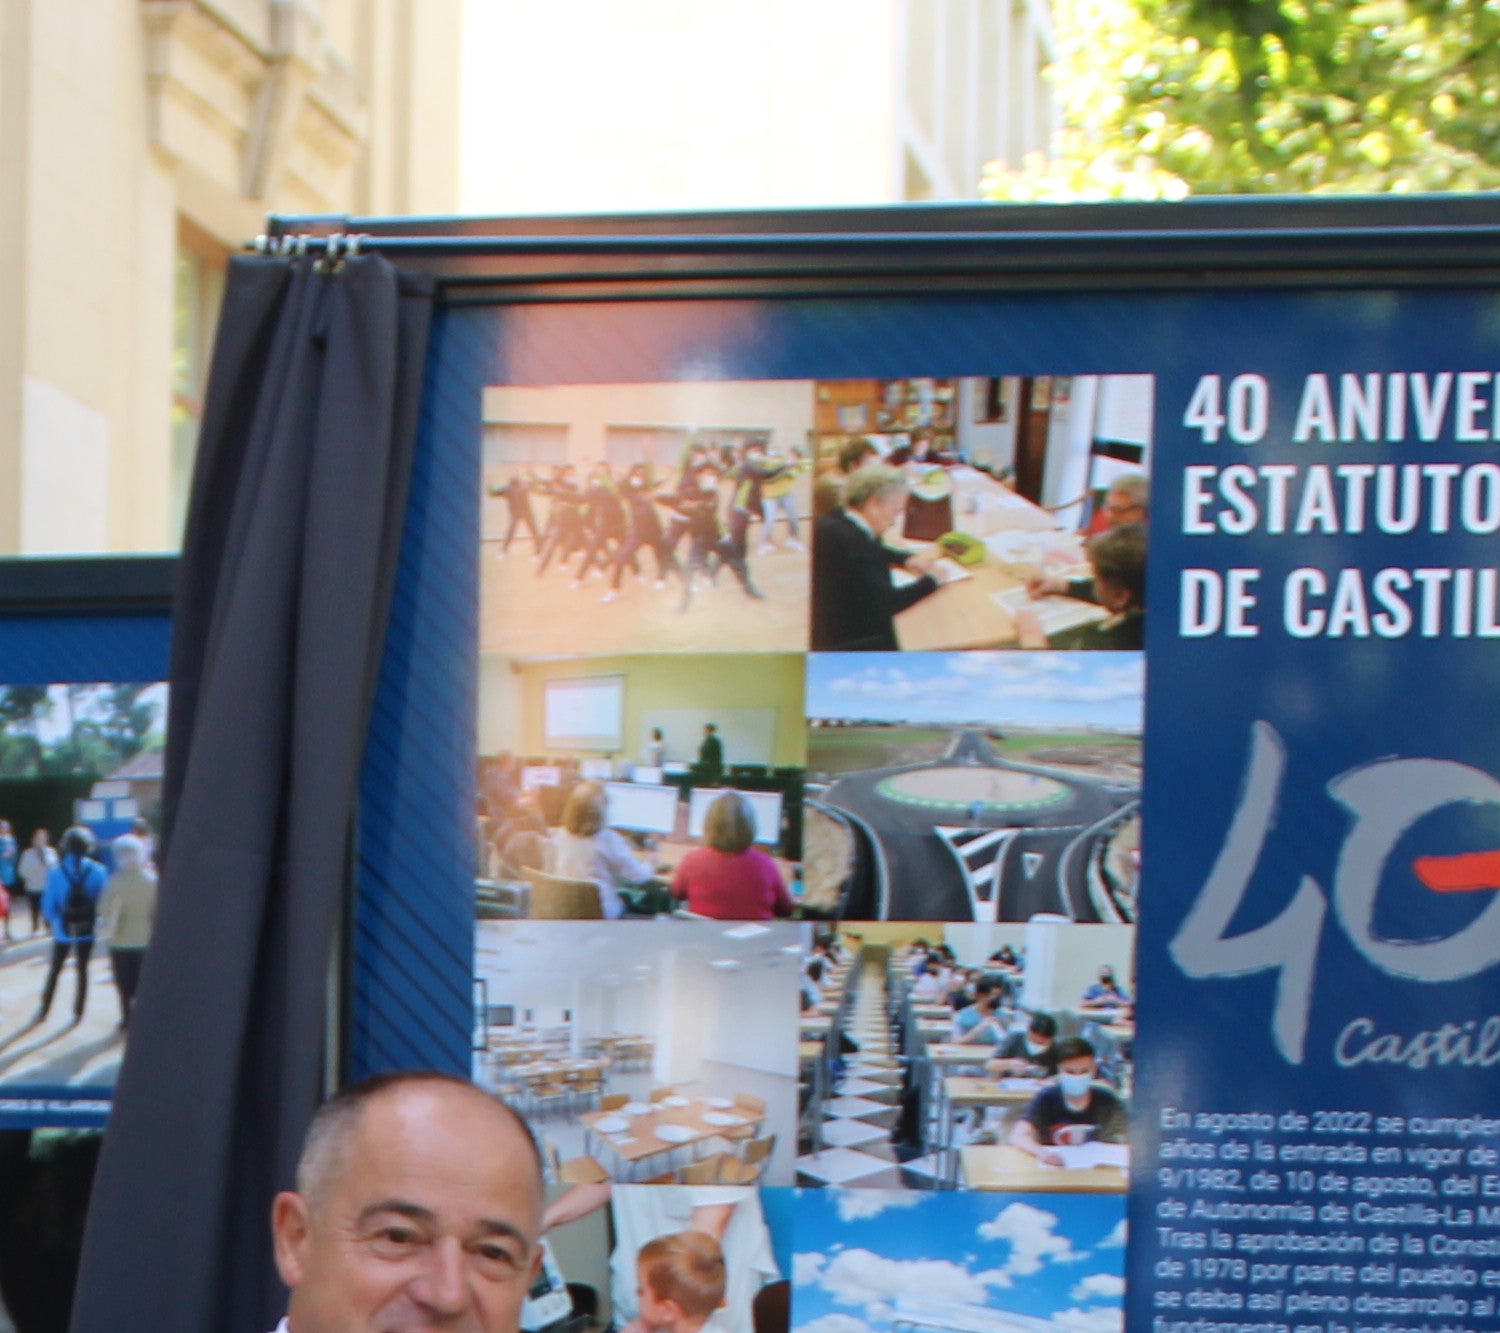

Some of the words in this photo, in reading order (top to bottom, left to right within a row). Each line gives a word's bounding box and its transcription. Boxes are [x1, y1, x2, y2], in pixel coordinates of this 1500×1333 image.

[1183, 373, 1268, 443] 40
[1180, 568, 1259, 638] DE
[1160, 1106, 1192, 1129] En
[1194, 1107, 1277, 1135] agosto
[1277, 1109, 1311, 1131] de
[1312, 1109, 1373, 1133] 2022
[1375, 1116, 1407, 1133] se
[1219, 1138, 1252, 1161] de
[1253, 1139, 1277, 1161] la
[1278, 1139, 1369, 1163] entrada
[1370, 1146, 1403, 1164] en
[1404, 1142, 1465, 1169] vigor
[1467, 1143, 1500, 1166] de
[1249, 1168, 1282, 1190] de
[1285, 1169, 1316, 1191] 10
[1316, 1169, 1350, 1192] de
[1440, 1173, 1478, 1195] del
[1156, 1196, 1188, 1219] de
[1317, 1200, 1351, 1223] de
[1351, 1201, 1475, 1226] Castilla-La
[1155, 1225, 1208, 1249] Tras
[1210, 1227, 1234, 1249] la
[1367, 1231, 1400, 1254] de
[1402, 1232, 1425, 1254] la
[1154, 1255, 1186, 1278] de
[1189, 1256, 1248, 1279] 1978
[1250, 1262, 1292, 1285] por
[1293, 1259, 1358, 1287] parte
[1357, 1261, 1396, 1284] del
[1398, 1262, 1479, 1290] pueblo
